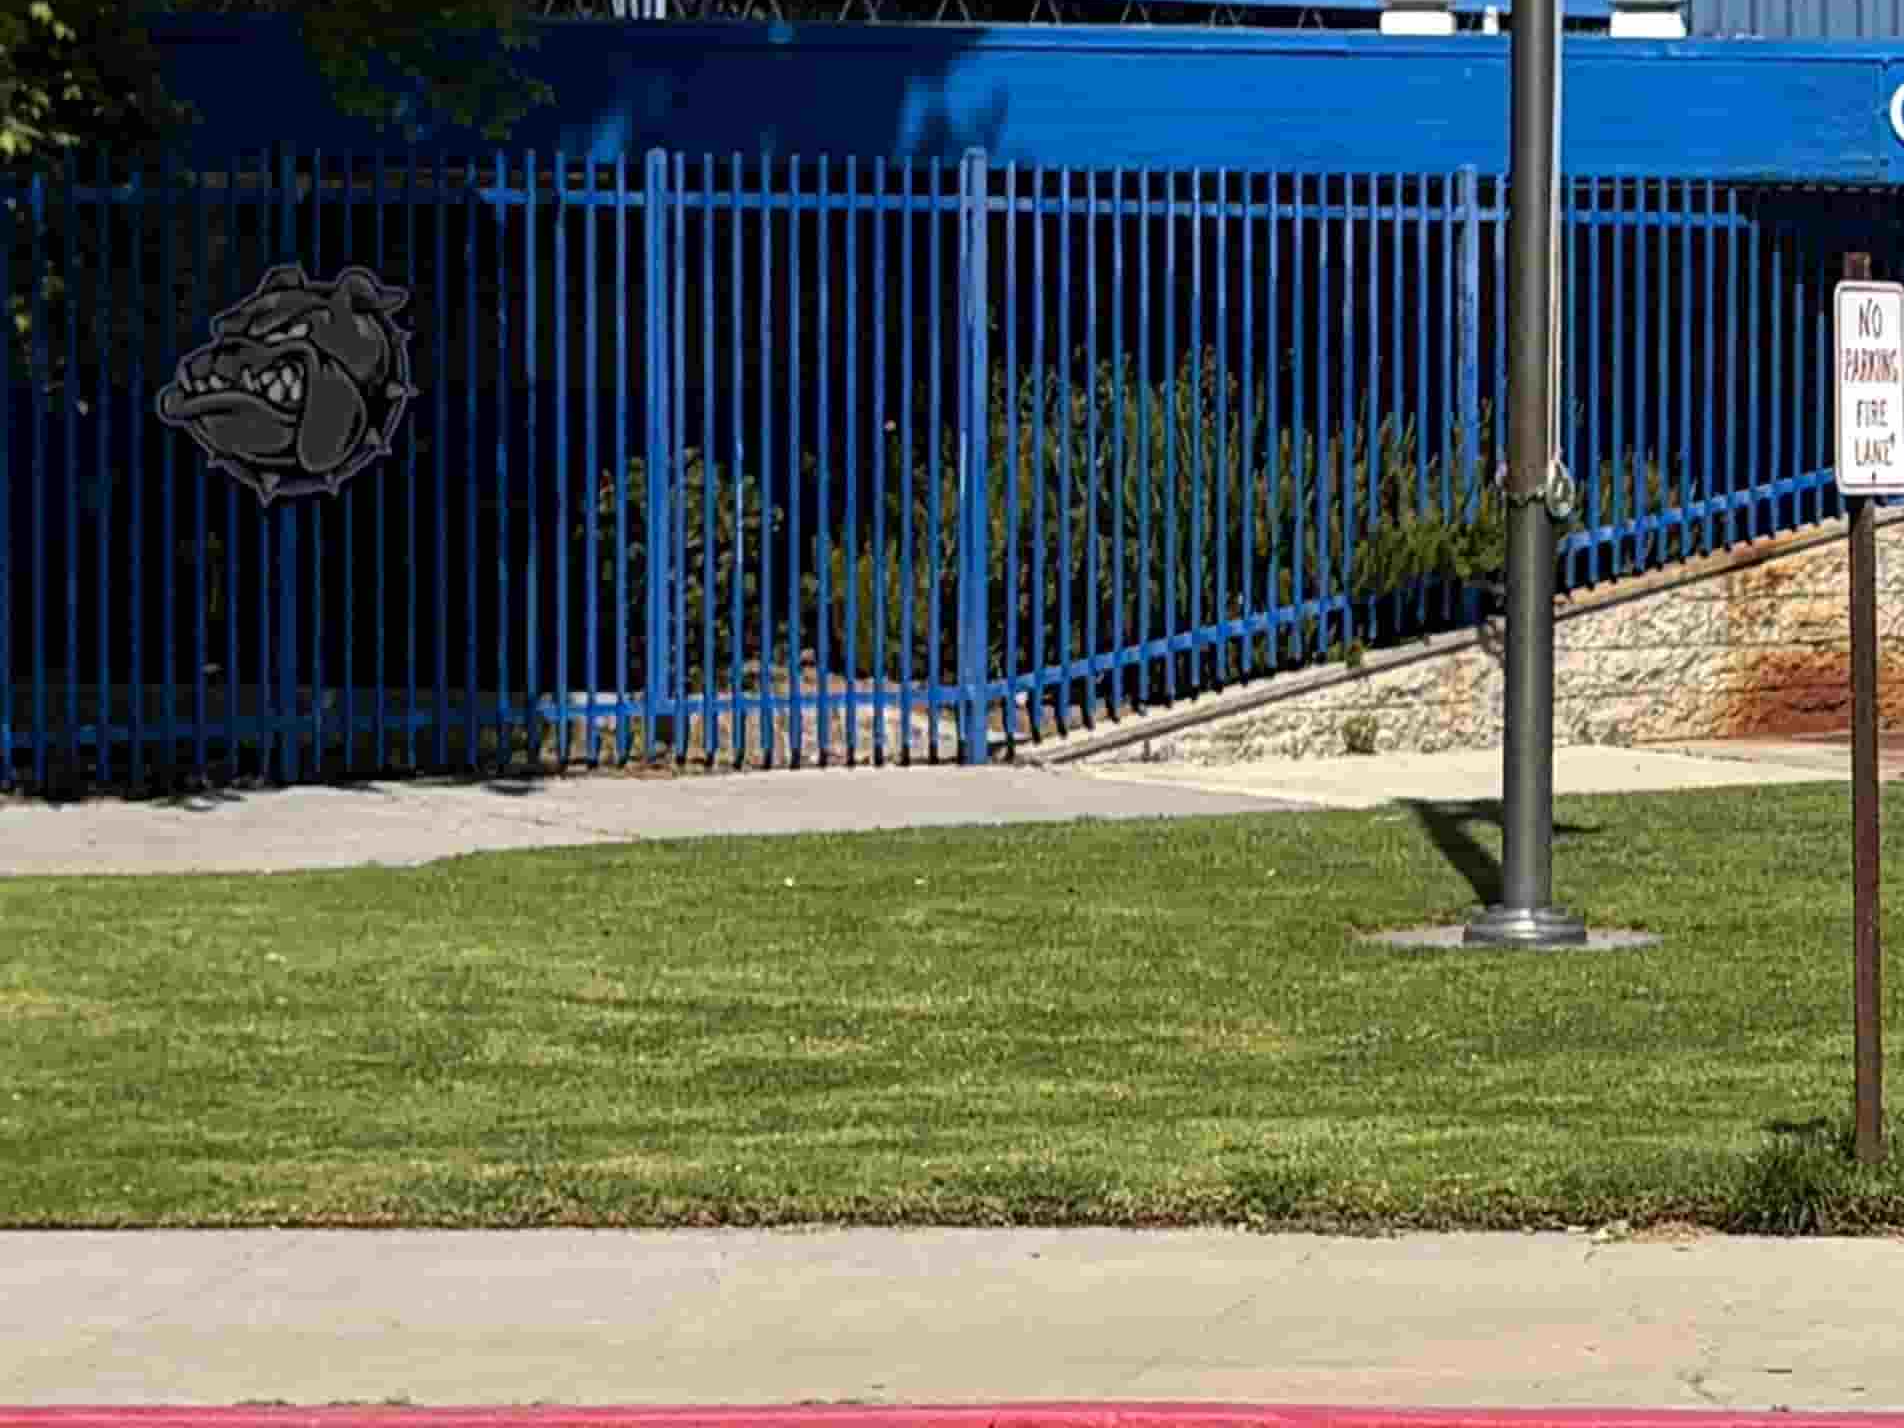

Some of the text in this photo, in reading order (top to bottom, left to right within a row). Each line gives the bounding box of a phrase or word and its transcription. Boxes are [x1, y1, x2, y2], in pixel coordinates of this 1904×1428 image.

[1858, 299, 1884, 338] NO
[1844, 347, 1898, 384] PARKING
[1856, 399, 1888, 428] FIRE
[1855, 437, 1893, 466] LANE
